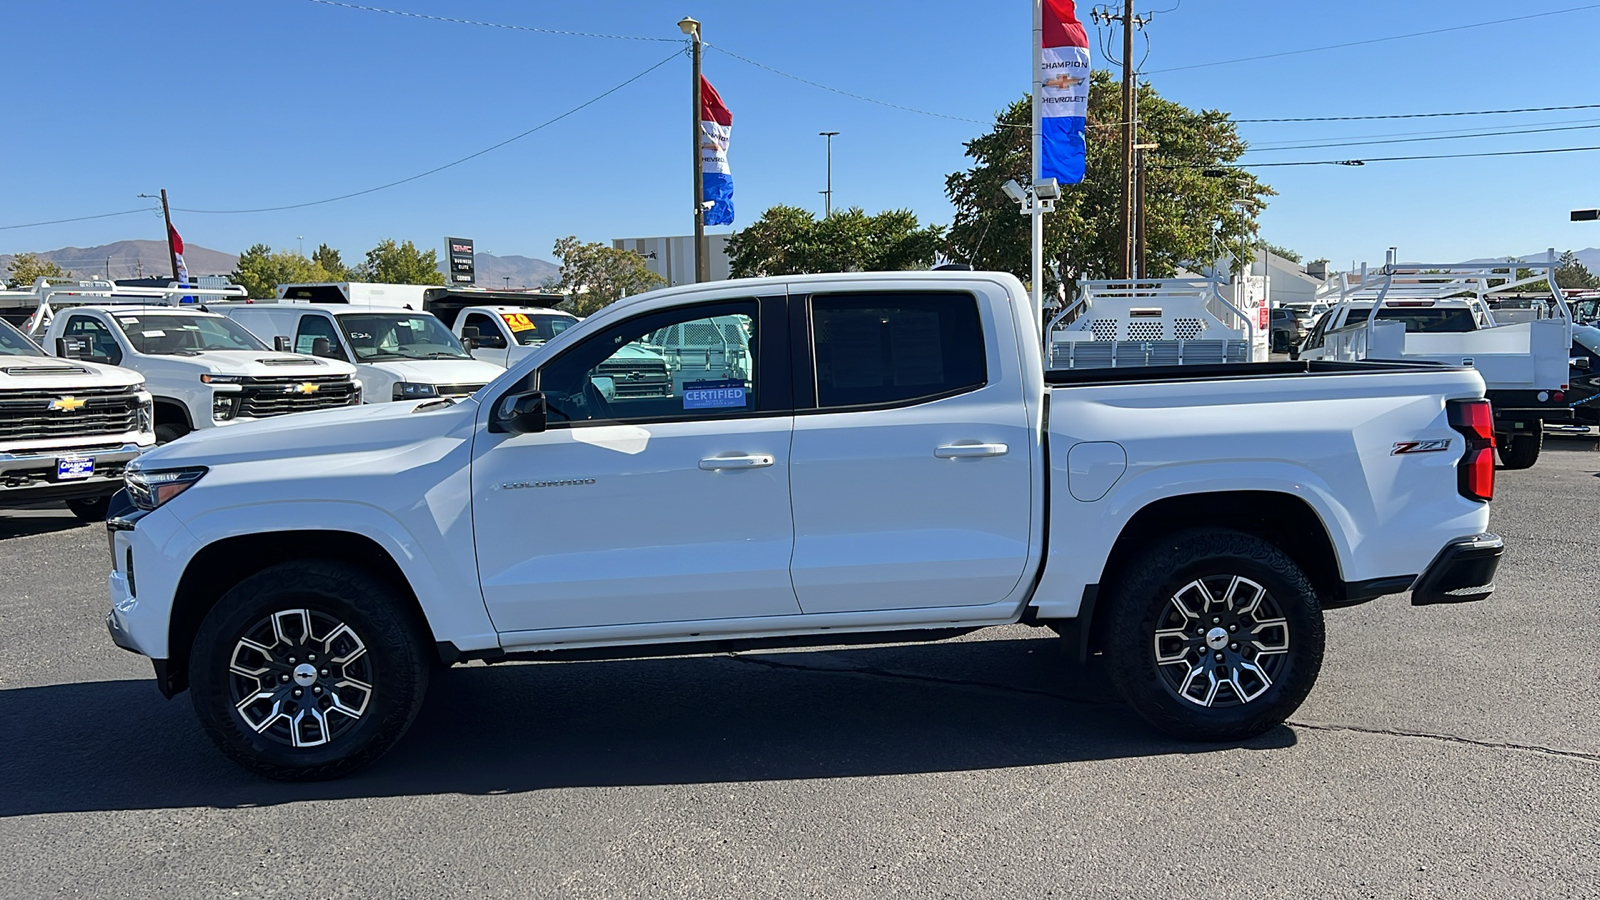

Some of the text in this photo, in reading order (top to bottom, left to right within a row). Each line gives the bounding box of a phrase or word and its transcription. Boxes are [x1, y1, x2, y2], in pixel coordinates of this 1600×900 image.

[453, 244, 472, 253] GMC
[685, 389, 743, 401] CERTIFIED
[1390, 438, 1452, 456] Z71
[503, 478, 596, 490] COLORADO
